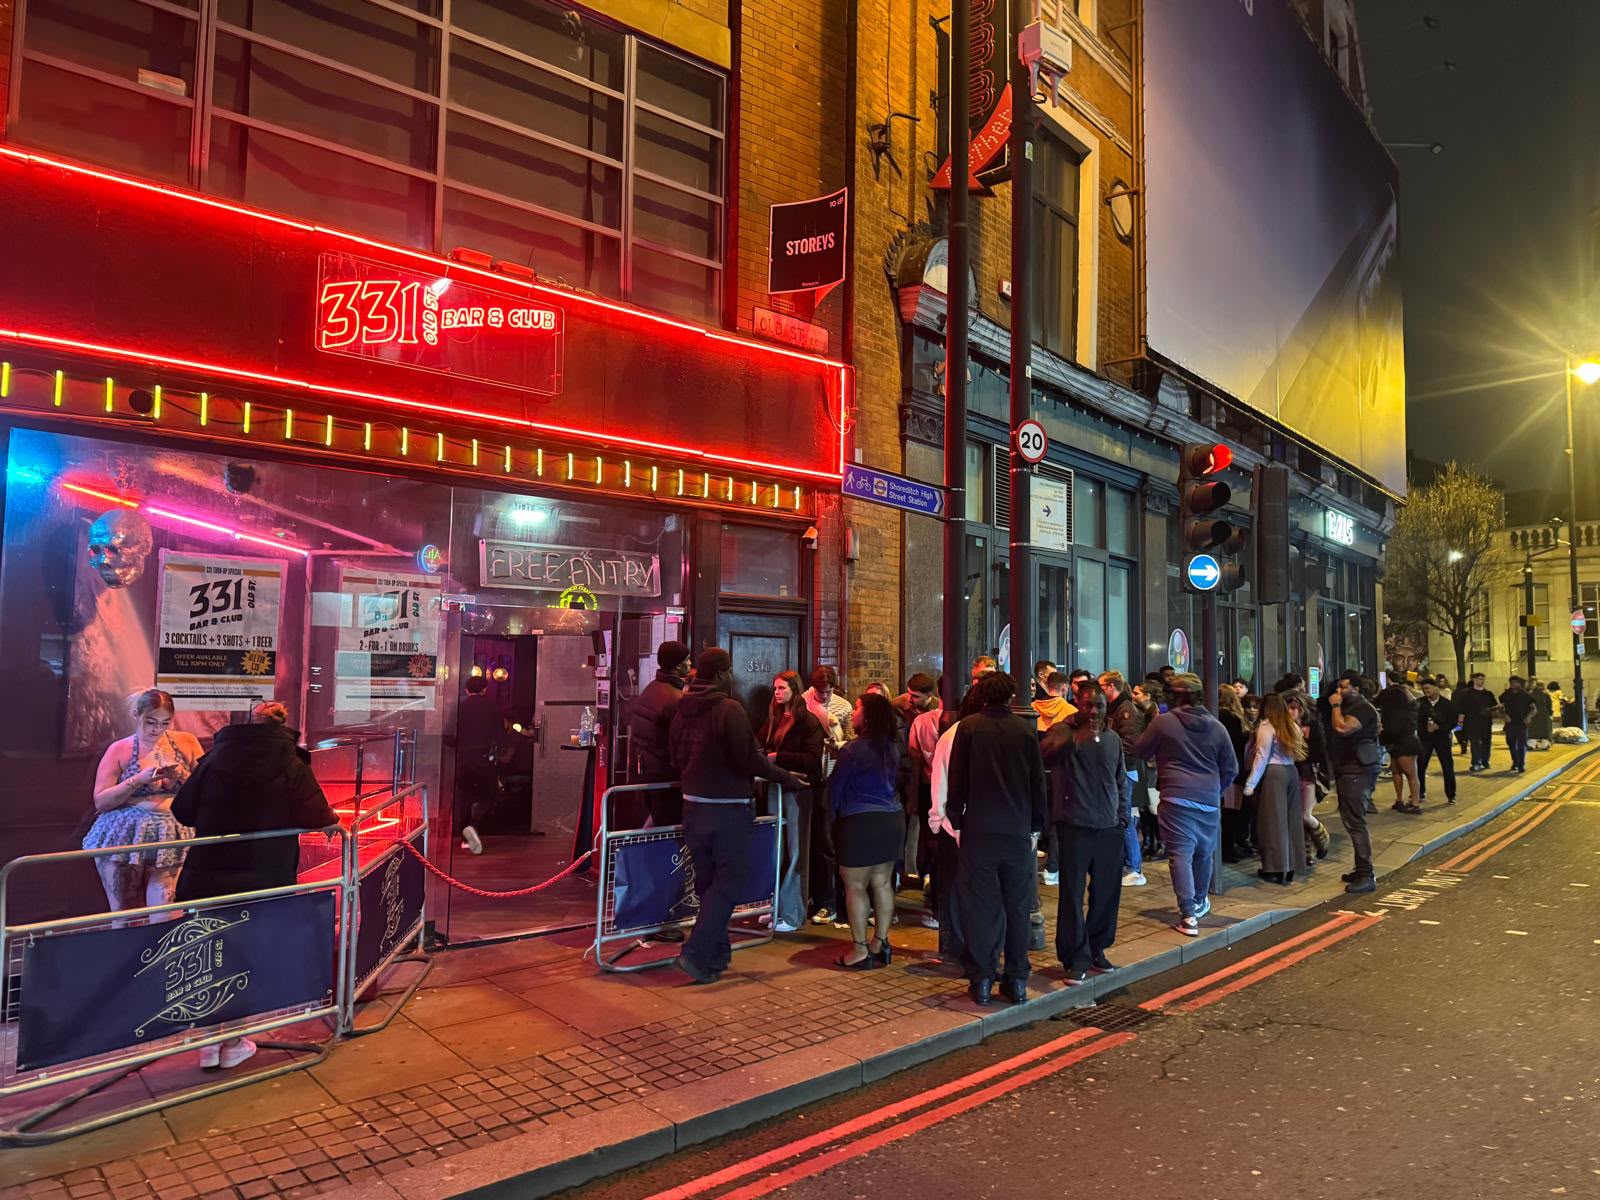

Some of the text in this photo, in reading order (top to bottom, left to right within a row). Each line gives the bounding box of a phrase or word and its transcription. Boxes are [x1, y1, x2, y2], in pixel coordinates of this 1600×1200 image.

[786, 232, 835, 256] STOREYS
[320, 280, 420, 348] 331
[441, 308, 556, 330] BAR & CLUB
[422, 312, 438, 345] OLD
[760, 316, 782, 336] OLD
[1021, 432, 1042, 450] 20
[889, 482, 919, 496] Shoreditch
[920, 490, 934, 500] High
[889, 491, 928, 507] Street Station
[490, 548, 654, 588] FREE ENTRY
[189, 578, 243, 618] 331
[190, 620, 208, 631] BAR
[220, 614, 243, 624] CLUB
[364, 627, 380, 638] BAR
[165, 632, 170, 644] 3
[171, 633, 207, 646] COCKTAILS
[216, 635, 221, 646] 3
[223, 635, 243, 647] SHOTS
[252, 636, 255, 646] 1
[256, 636, 272, 647] BEER
[360, 640, 363, 650] 2
[369, 641, 379, 651] FOR
[384, 641, 387, 651] 1
[390, 642, 398, 652] ON
[399, 642, 419, 652] DRINKS
[165, 940, 212, 990] 331
[166, 987, 184, 1002] BAR
[193, 974, 212, 987] CLUB
